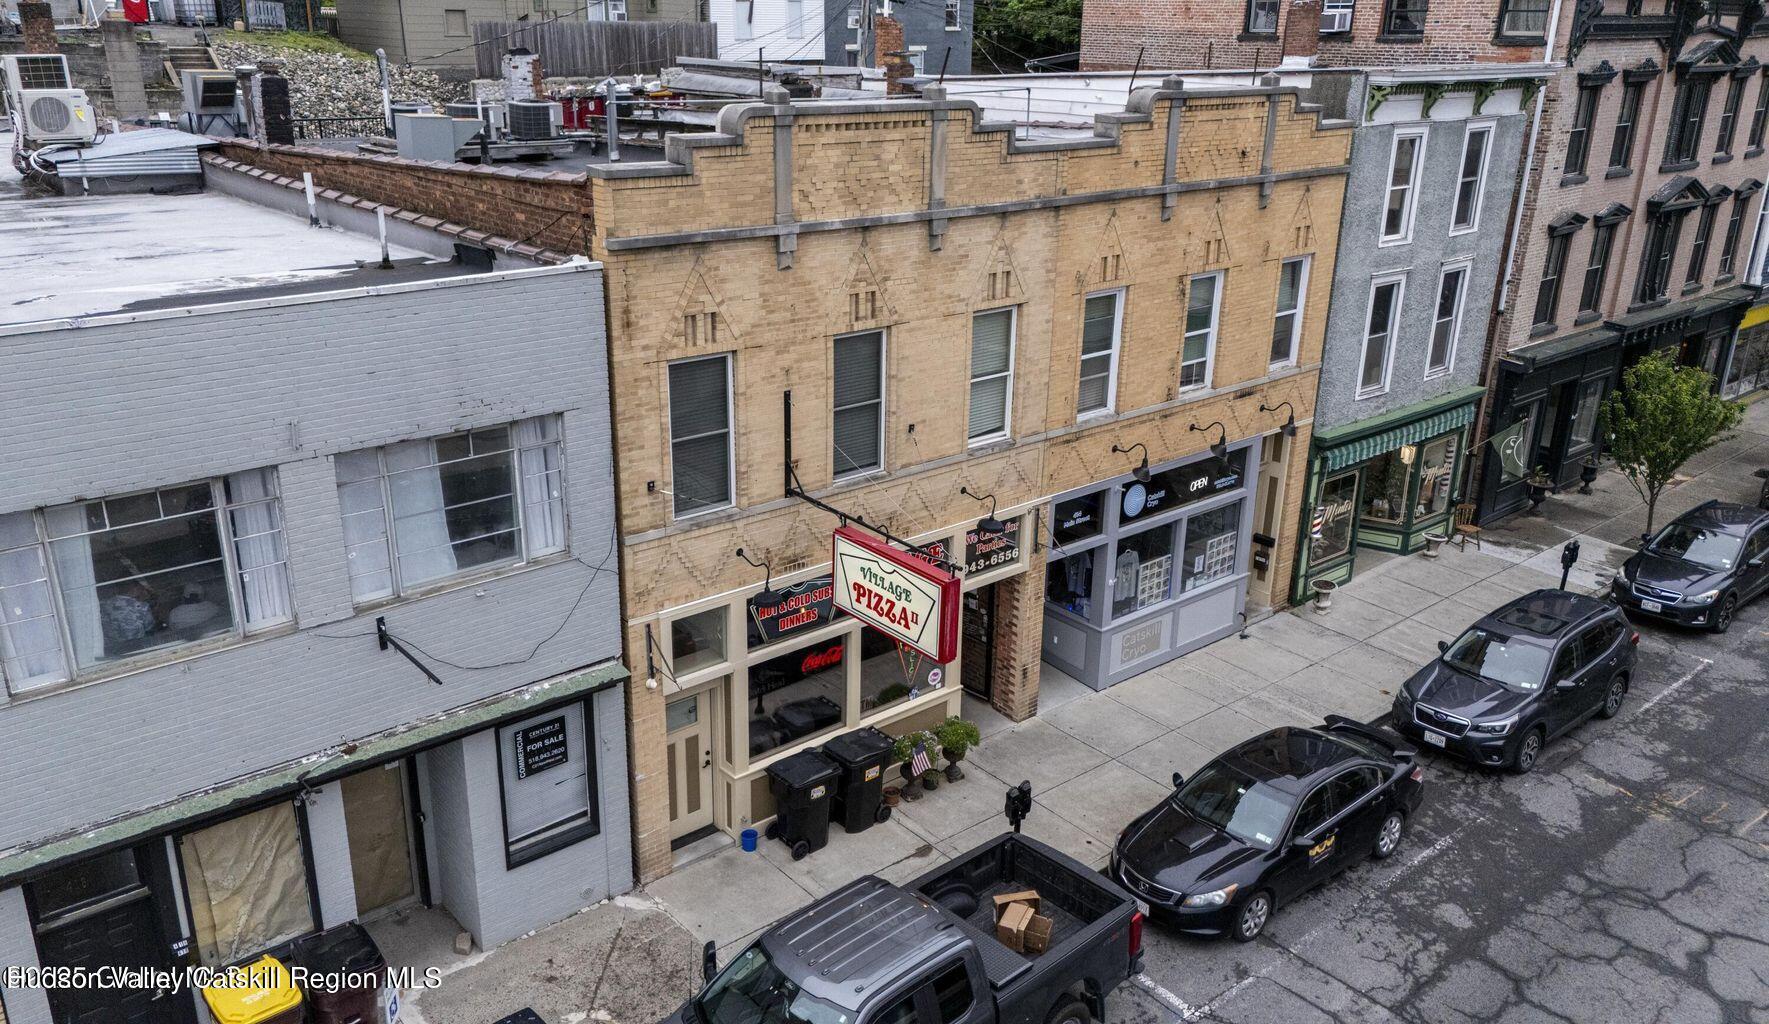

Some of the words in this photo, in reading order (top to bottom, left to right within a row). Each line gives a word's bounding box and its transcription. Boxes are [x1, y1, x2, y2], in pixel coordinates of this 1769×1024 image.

[1190, 476, 1208, 491] OPEN
[965, 532, 979, 546] We
[1005, 521, 1020, 534] for
[976, 538, 1007, 555] Parties
[962, 547, 1020, 575] 943-6556
[860, 566, 913, 604] VILLAGE
[779, 602, 787, 614] &
[788, 592, 811, 611] COLD
[853, 582, 911, 631] PIZZA
[779, 608, 818, 632] DINNERS
[1122, 621, 1161, 647] Catskill
[527, 741, 543, 752] FOR
[544, 733, 564, 746] SALE
[529, 725, 554, 737] CENTURY
[516, 731, 526, 779] COMMERCIAL
